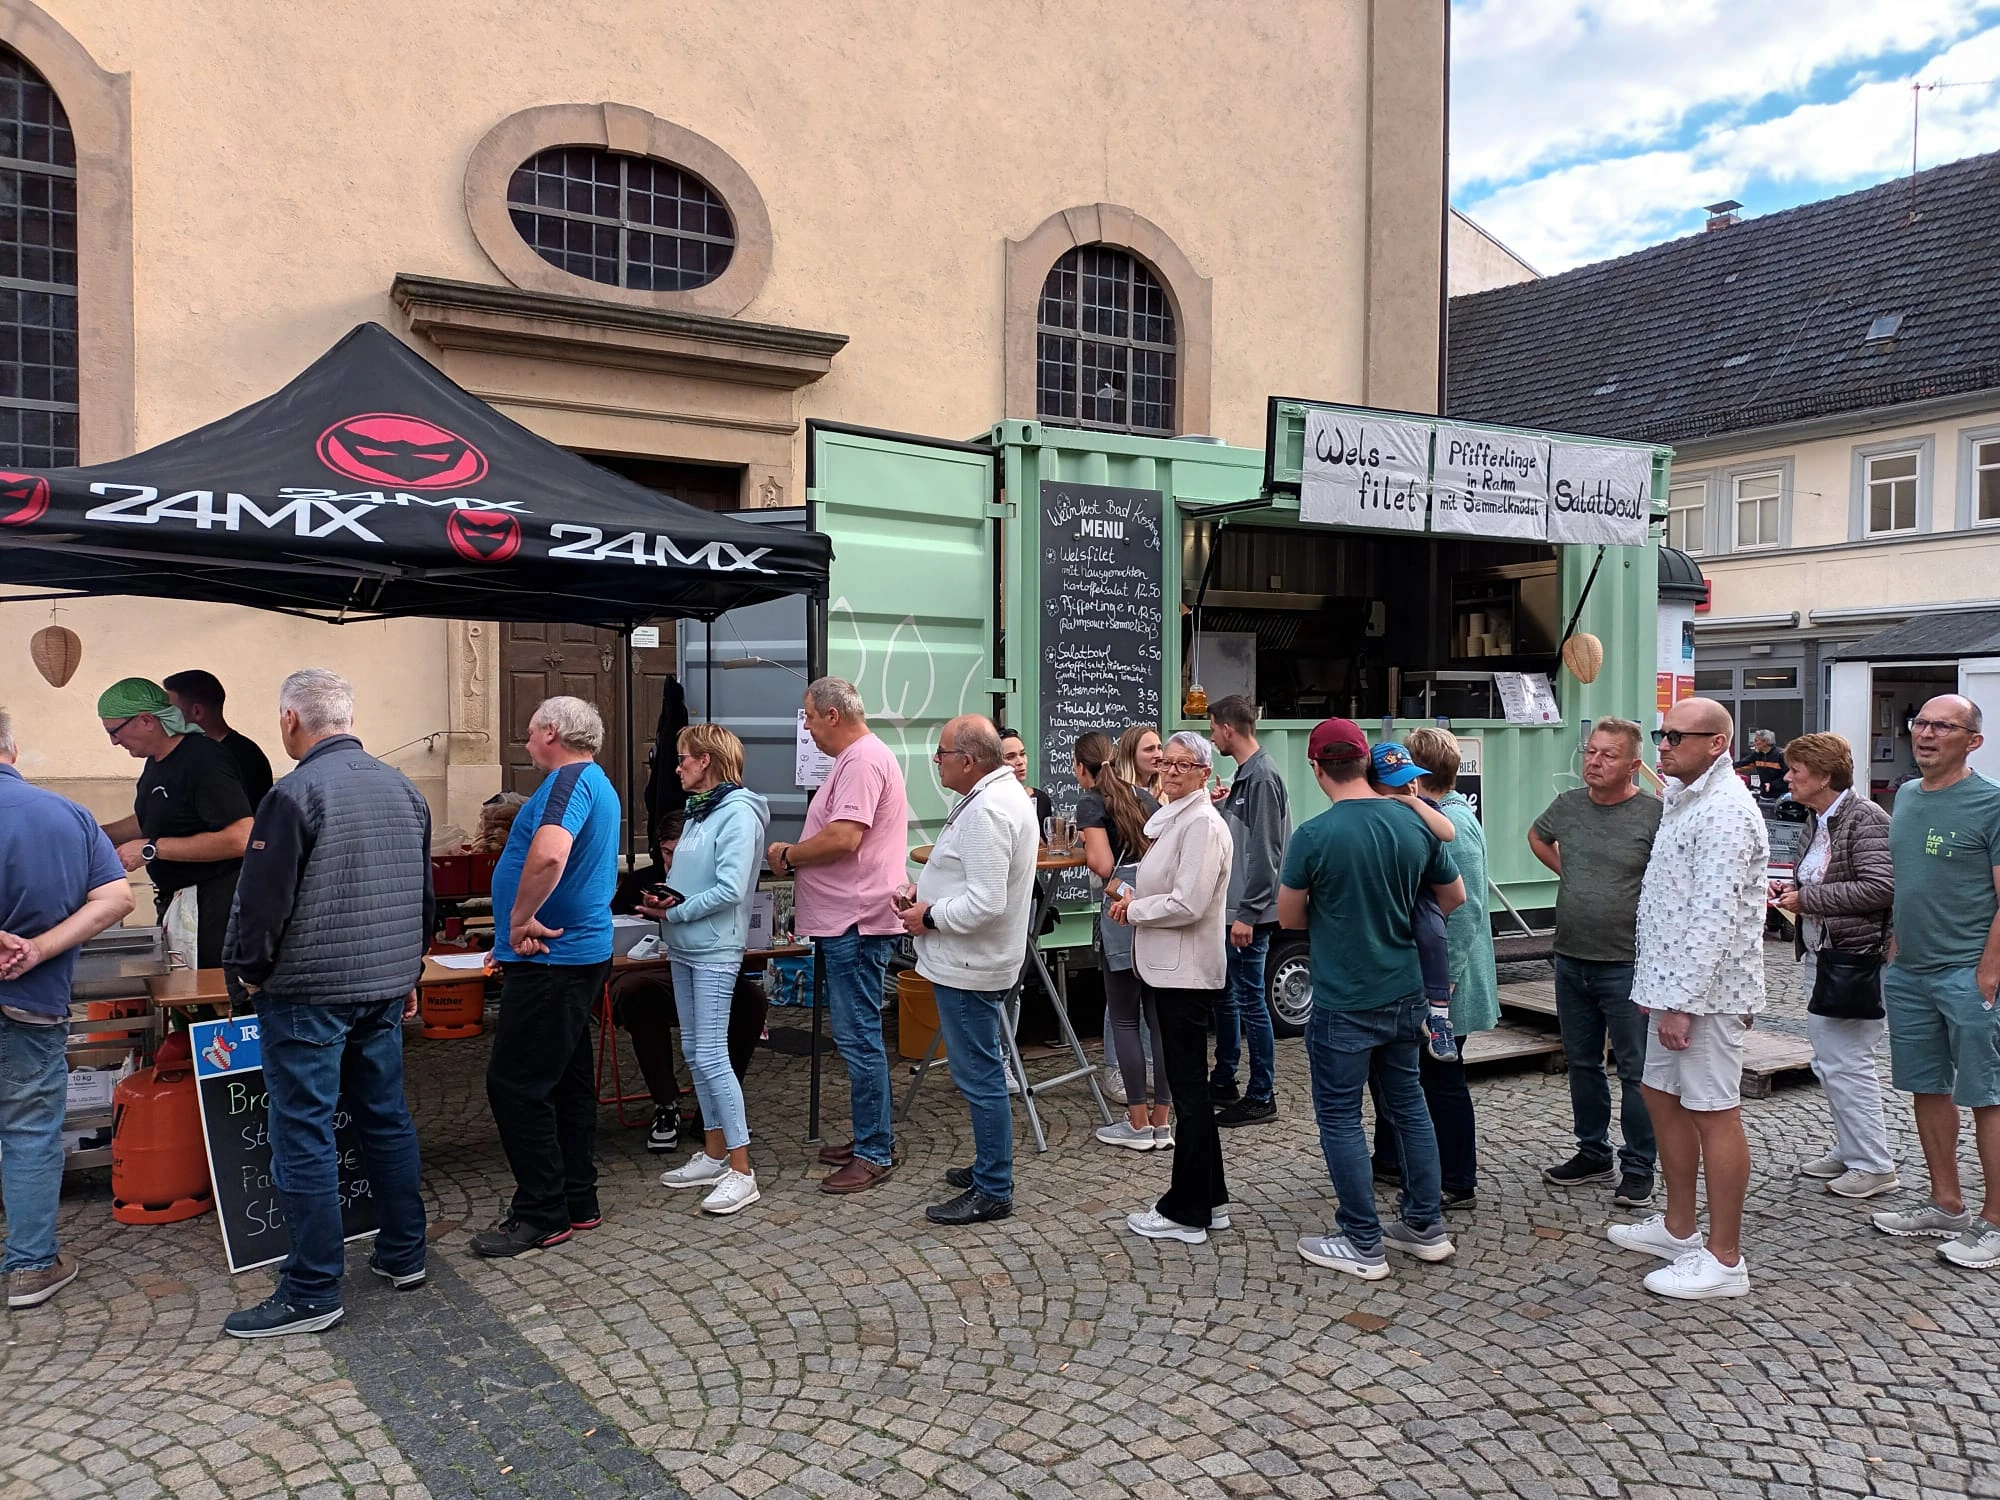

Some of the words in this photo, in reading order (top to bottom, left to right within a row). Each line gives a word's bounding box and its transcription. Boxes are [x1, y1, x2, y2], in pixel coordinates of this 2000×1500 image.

[1316, 427, 1396, 467] Wels-
[1448, 440, 1537, 478] Pfifferlinge
[1359, 471, 1416, 512] filet
[1466, 472, 1477, 489] in
[1481, 469, 1516, 493] Rahm
[277, 487, 534, 514] 24MX
[1105, 498, 1132, 518] Bad
[1439, 494, 1456, 510] mit
[1554, 479, 1644, 520] Salatbowl
[85, 482, 384, 543] 24MX
[1081, 518, 1124, 540] MENU
[548, 523, 779, 575] 24MX
[1060, 545, 1115, 568] Welsfilet
[1061, 564, 1080, 577] mit
[1063, 579, 1129, 598] Kartoffelsalat
[1127, 602, 1137, 616] in
[1057, 641, 1113, 663] Salatbowl
[1138, 644, 1162, 661] 6.50
[1137, 688, 1159, 702] 3.50
[1137, 702, 1159, 717] 3.50
[427, 996, 465, 1006] Walther
[72, 1074, 81, 1082] 10
[82, 1074, 92, 1082] kg
